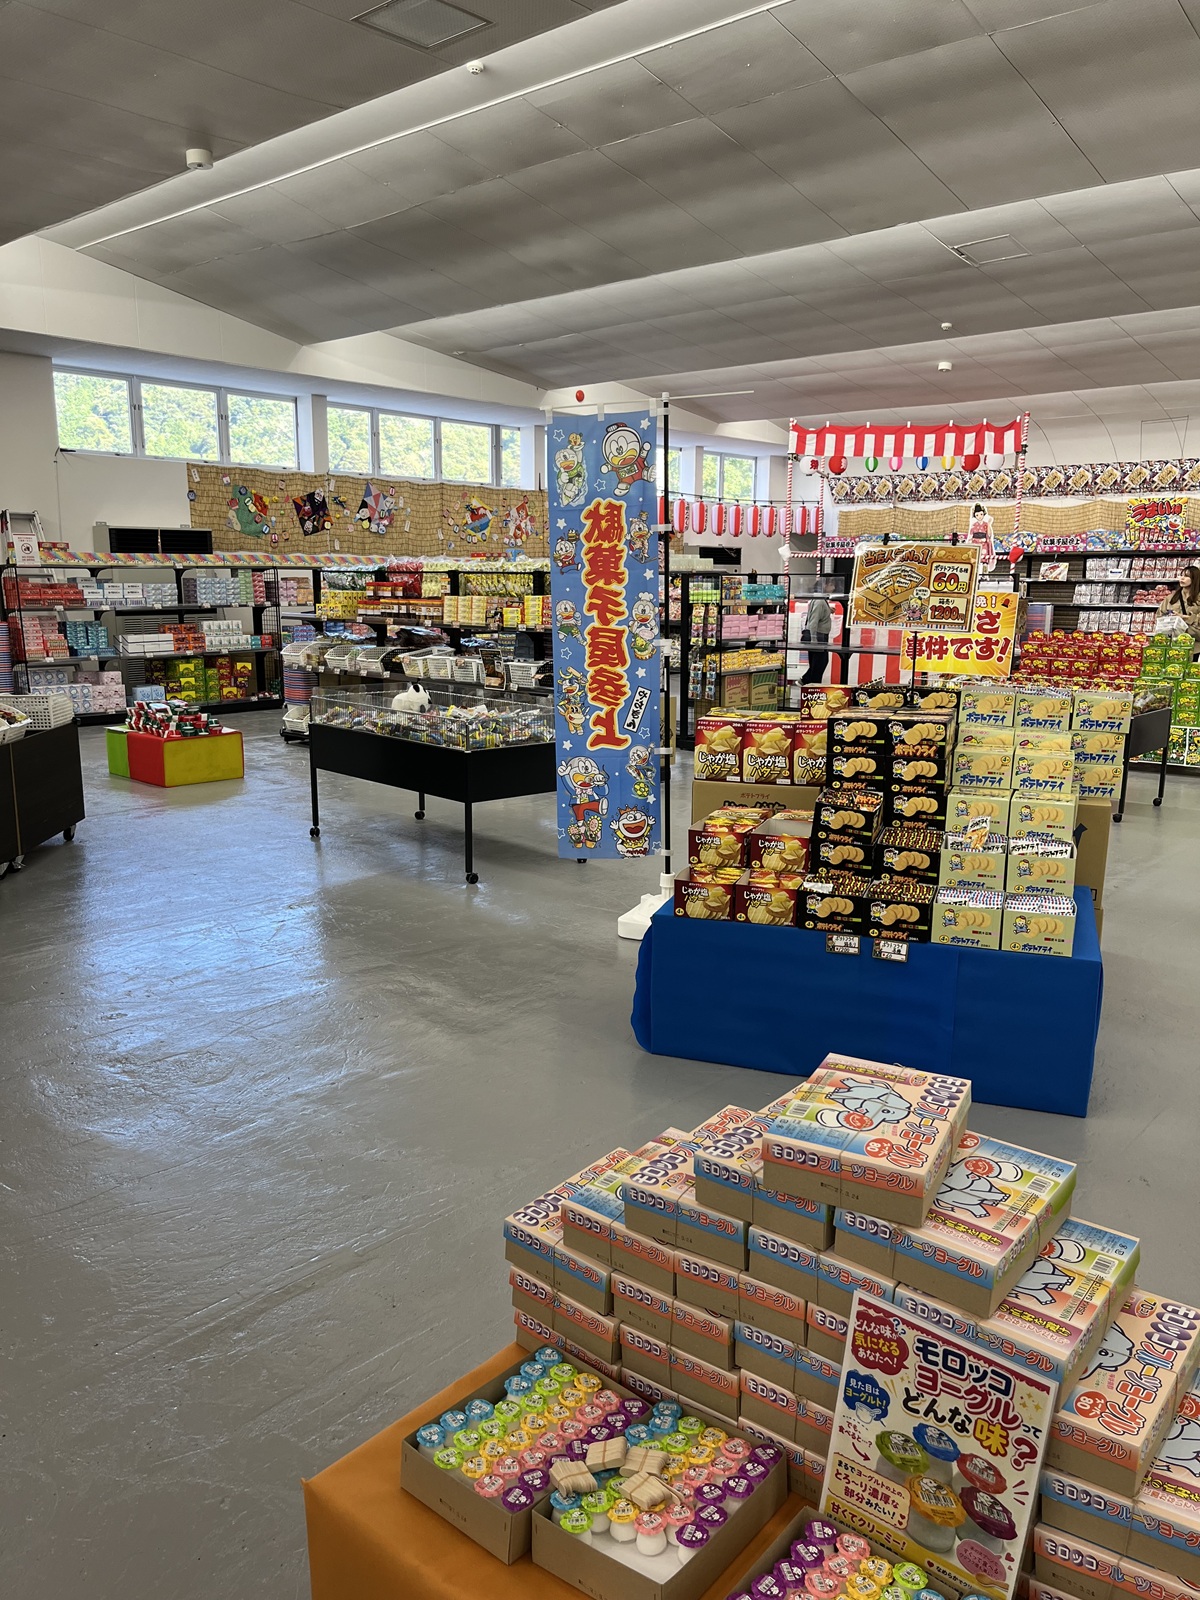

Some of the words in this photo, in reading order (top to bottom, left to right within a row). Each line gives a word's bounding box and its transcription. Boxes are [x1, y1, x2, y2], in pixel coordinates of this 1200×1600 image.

[1131, 500, 1182, 522] うまい棒
[864, 548, 931, 567] 当店人気No.1
[933, 573, 968, 592] 60円
[975, 595, 998, 608] 発!
[974, 610, 1001, 634] さ
[906, 635, 1012, 663] 事件です!
[966, 712, 1007, 724] ポテトフライ
[1021, 717, 1062, 729] ポテトフライ
[1080, 718, 1123, 731] ポテトフライ
[699, 752, 736, 765] じゃが塩
[895, 745, 937, 757] ポテトフライ
[701, 764, 730, 774] バター
[748, 755, 787, 768] じゃが塩
[750, 767, 780, 778] バター
[959, 774, 1003, 786] ポテトフライ
[1019, 778, 1065, 791] ポテトフライ
[1080, 786, 1114, 797] テトフライ
[695, 836, 721, 845] じゃが塩
[758, 840, 785, 850] じゃが塩
[682, 886, 709, 897] じゃが塩
[957, 880, 985, 889] ポテトフライ
[1025, 886, 1055, 894] ポテトフライ
[744, 891, 772, 902] じゃが塩
[950, 936, 980, 946] ポテトフライ
[1022, 943, 1053, 953] ポテトフライ
[886, 1076, 966, 1168] モロッコフルーツヨーグル
[771, 1143, 915, 1191] モロッコフルーツヨーグル
[628, 1187, 737, 1235] モロッコフルーツヨーグル
[567, 1209, 668, 1264] モロッコフルーツヨーグル
[844, 1210, 984, 1278] モロッコフルーツヨーグル
[510, 1225, 600, 1283] モロッコフルーツヨーグル
[758, 1234, 884, 1297] モロッコフルーツヨーグル
[681, 1258, 796, 1311] モロッコフルーツヨーグル
[515, 1273, 607, 1335] モロッコフルーツヨーグル
[617, 1280, 721, 1337] モロッコフルーツヨーグル
[854, 1331, 900, 1356] 気になる
[905, 1298, 1054, 1372] モロッコフルーツヨーグル
[626, 1331, 730, 1389] モロッコフルーツヨーグル
[857, 1347, 897, 1368] あなたへ!
[915, 1337, 1013, 1397] モロッコ
[1098, 1303, 1194, 1437] モロッコフルーツヨーグル
[849, 1377, 880, 1395] 見た目は
[845, 1387, 887, 1409] ヨーグルト!
[843, 1485, 897, 1520] 部分みたい!
[830, 1501, 907, 1551] 甘くてクリーミー!
